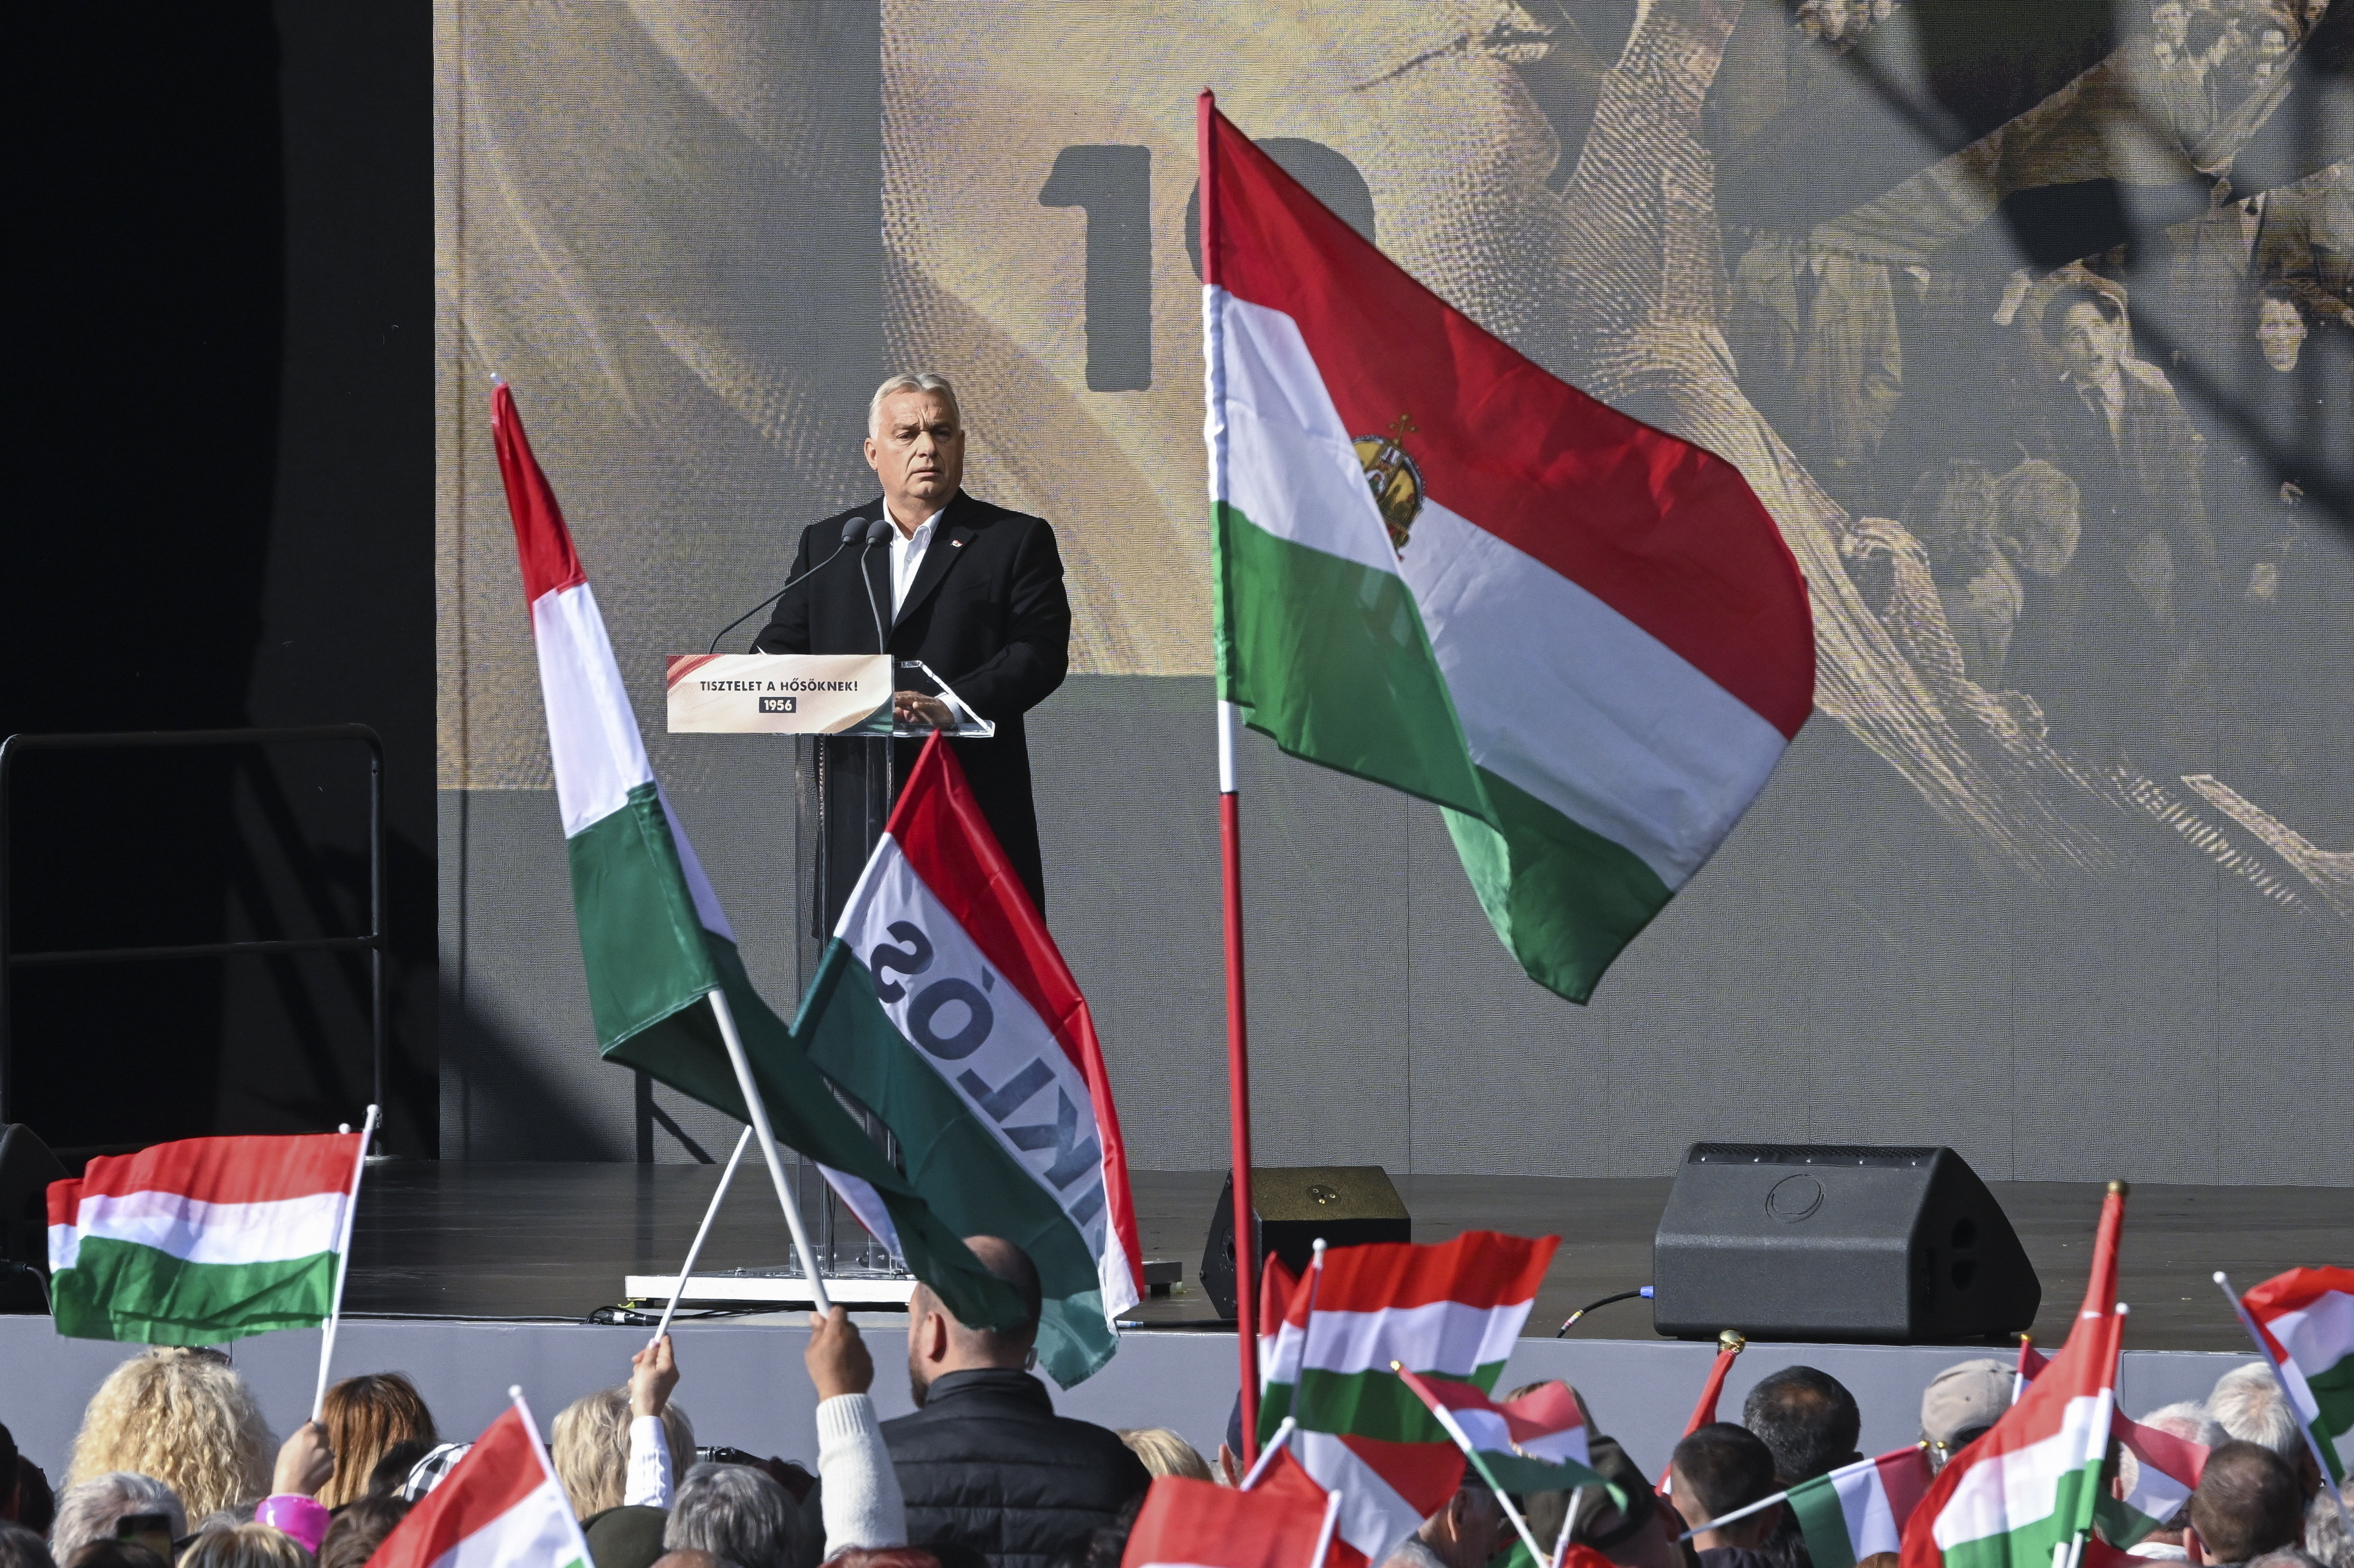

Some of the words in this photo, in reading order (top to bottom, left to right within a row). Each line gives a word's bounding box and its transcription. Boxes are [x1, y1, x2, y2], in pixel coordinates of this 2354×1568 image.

[700, 681, 762, 691] TISZTELET
[766, 681, 776, 691] A
[780, 677, 858, 692] HŐSÖKNEK!
[764, 699, 792, 711] 1956
